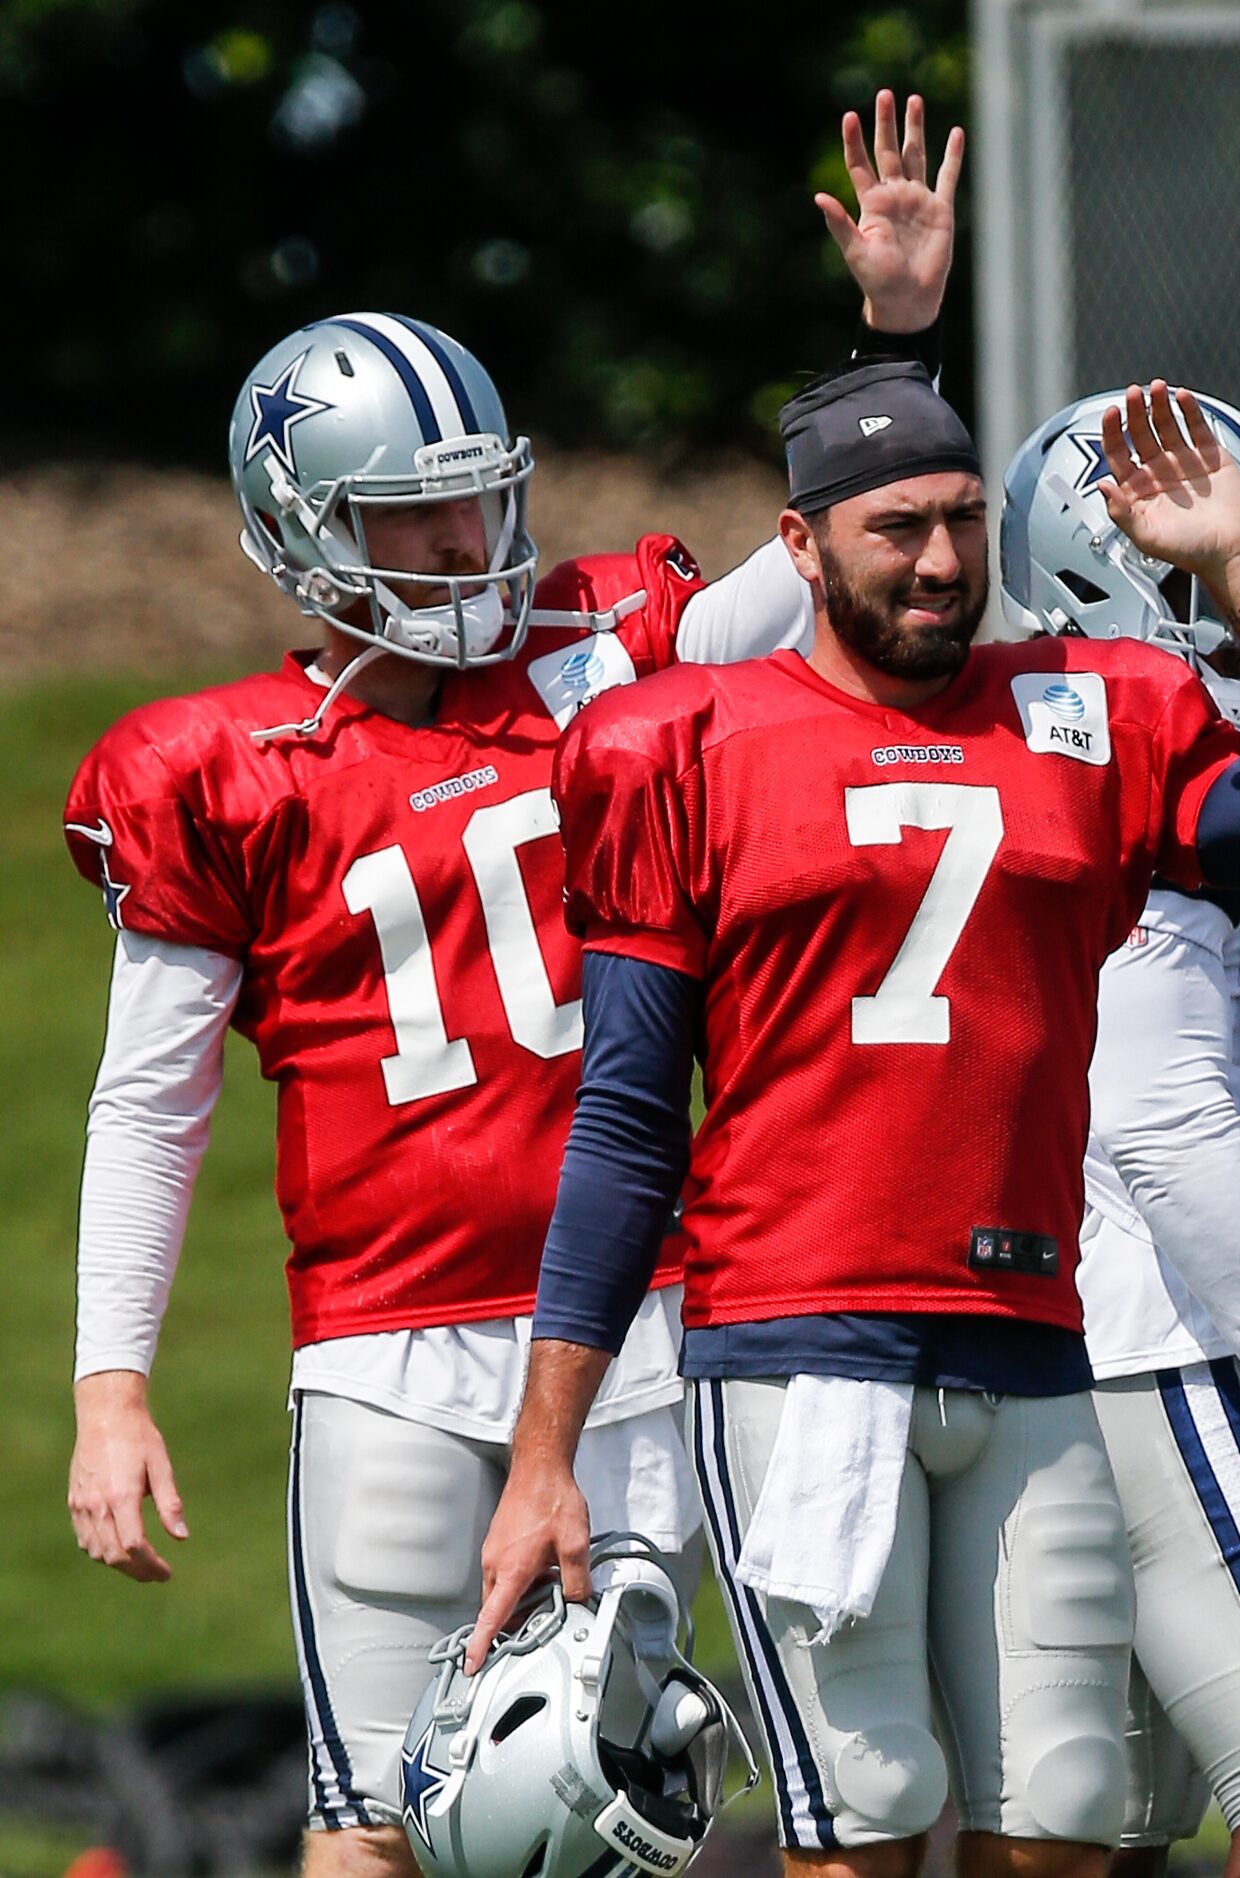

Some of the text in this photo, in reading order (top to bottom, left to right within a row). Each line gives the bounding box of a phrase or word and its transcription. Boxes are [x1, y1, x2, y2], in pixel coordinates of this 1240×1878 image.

[438, 446, 483, 463] COWBOYS
[873, 747, 963, 765] COWBOYS
[1050, 726, 1092, 751] AT&T
[845, 782, 1004, 1044] 7
[341, 786, 585, 1106] 10
[612, 1821, 678, 1870] COWBOYS
